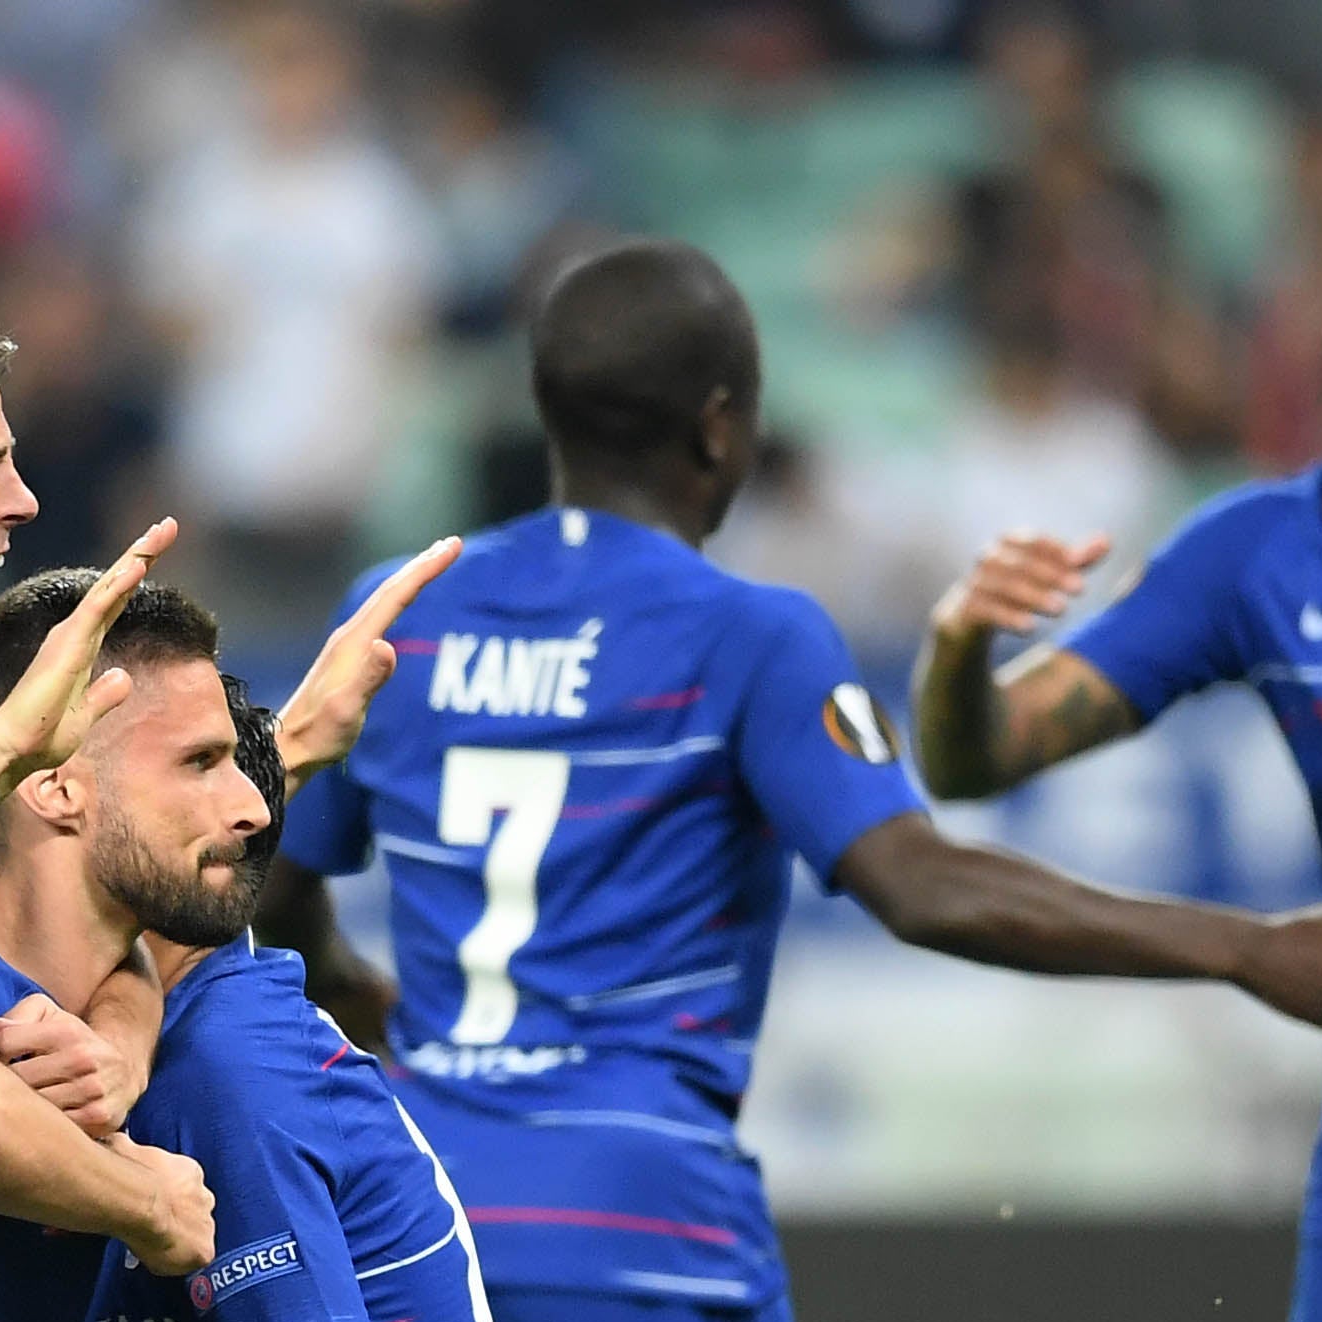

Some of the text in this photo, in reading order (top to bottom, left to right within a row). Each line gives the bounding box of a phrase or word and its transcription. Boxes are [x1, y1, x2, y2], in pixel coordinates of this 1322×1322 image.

[429, 617, 604, 718] KANTÉ
[438, 746, 570, 1045] 7
[211, 1241, 297, 1291] RESPECT
